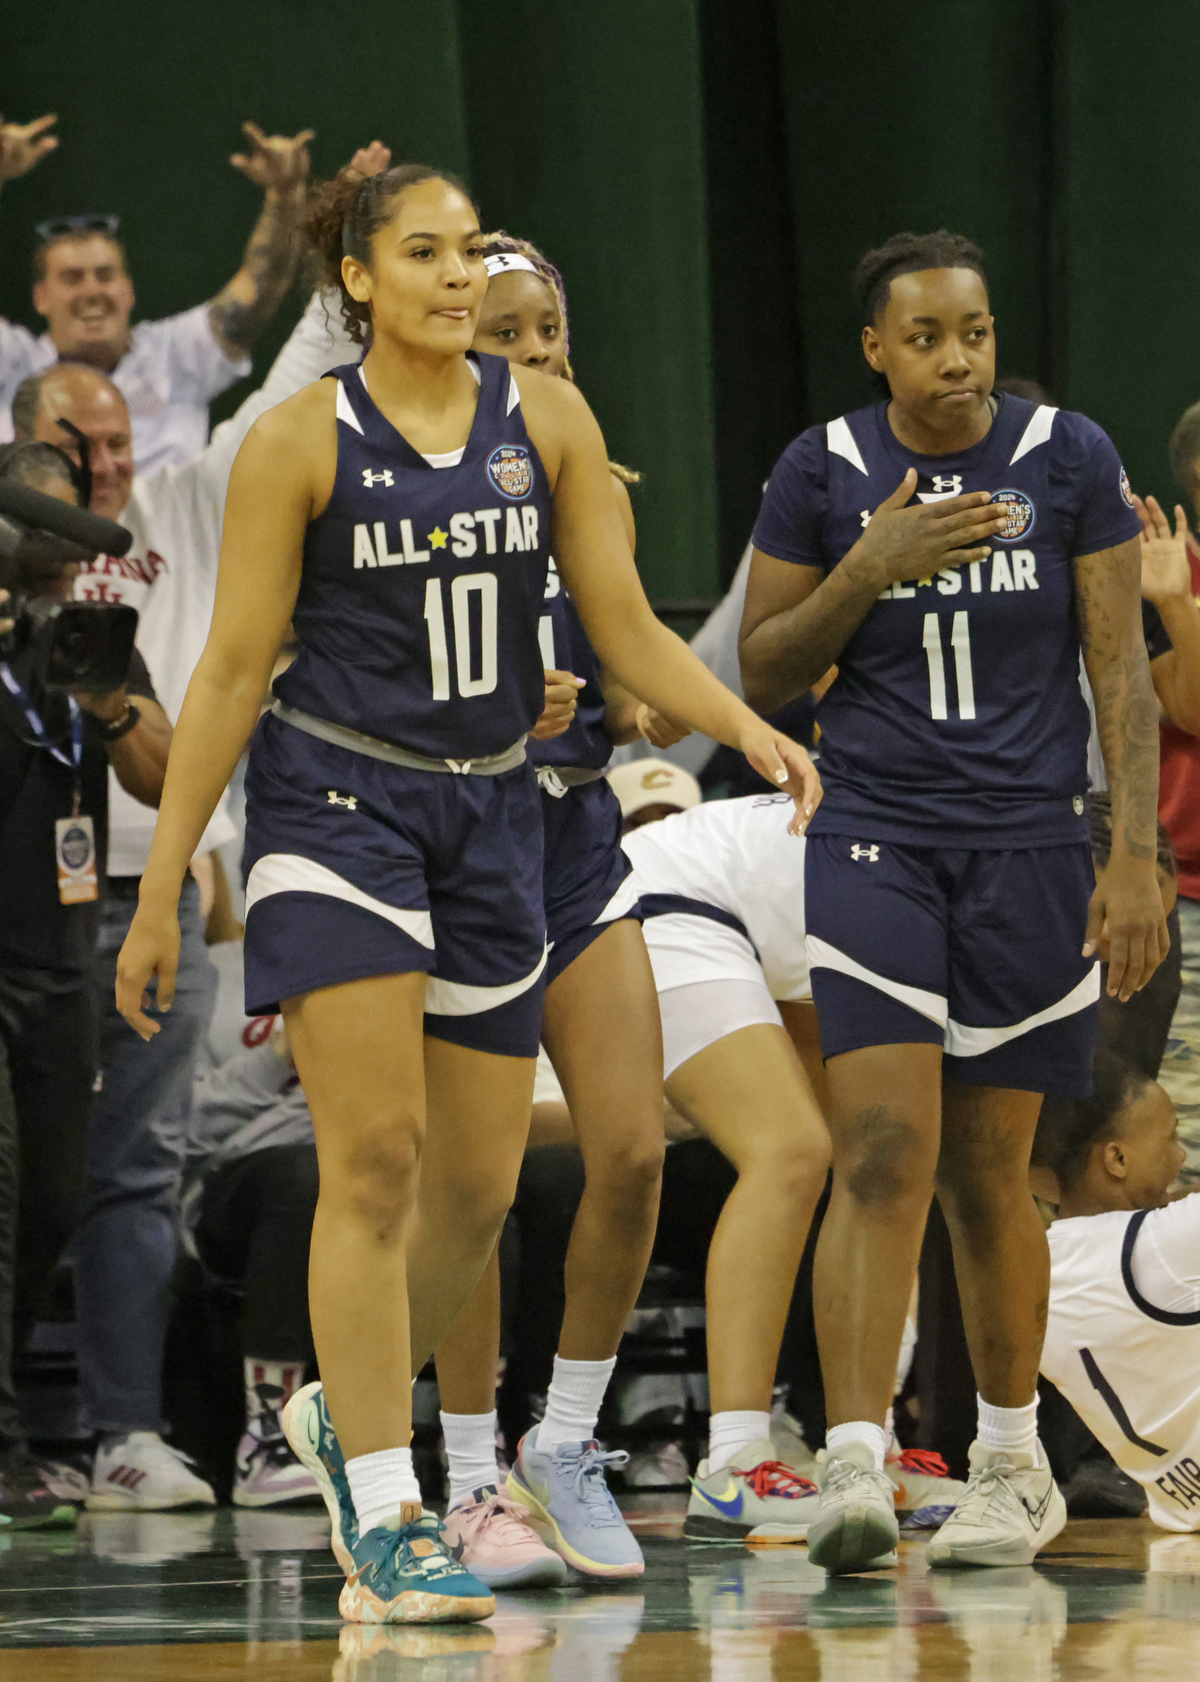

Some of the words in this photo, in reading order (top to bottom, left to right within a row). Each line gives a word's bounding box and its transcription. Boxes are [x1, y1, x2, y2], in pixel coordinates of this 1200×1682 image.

[353, 519, 430, 569] ALL
[449, 505, 539, 558] STAR
[424, 572, 498, 701] 10
[922, 611, 976, 720] 11
